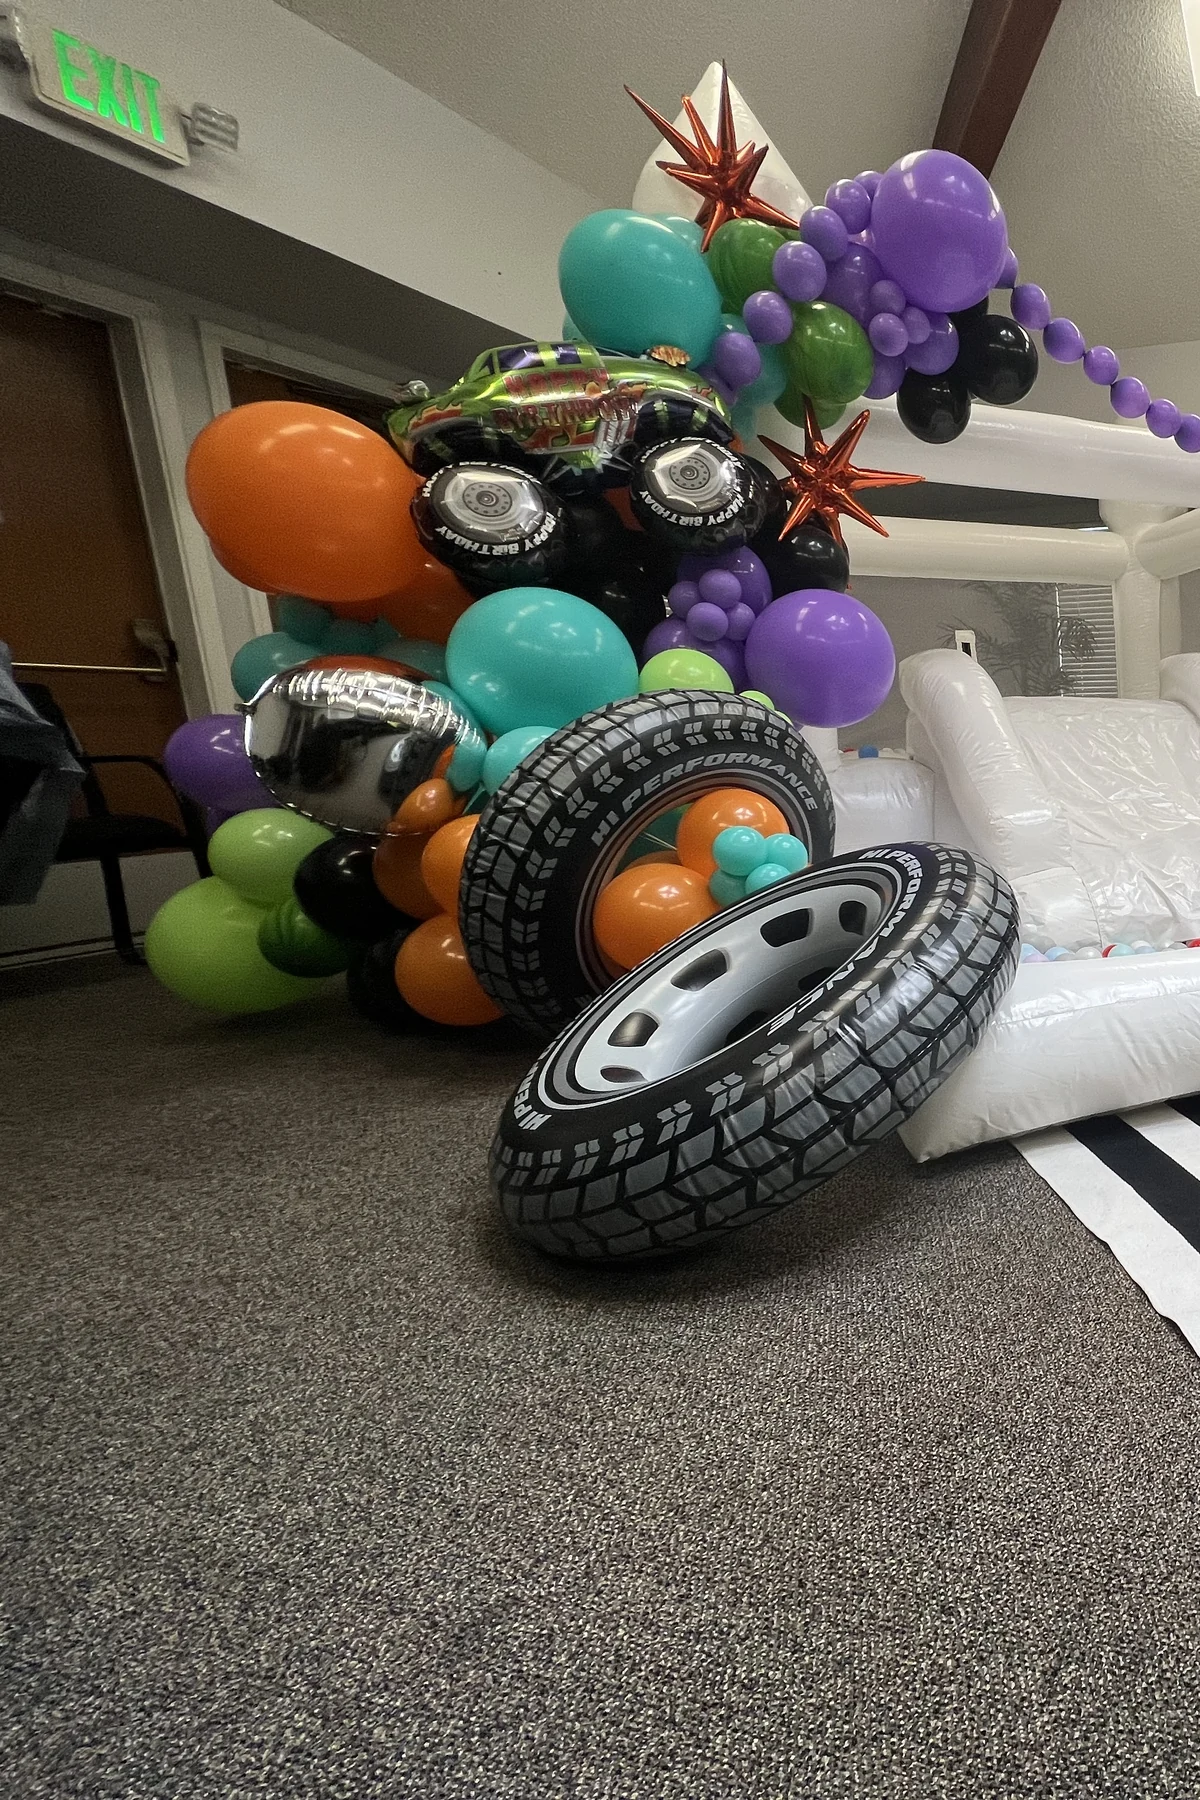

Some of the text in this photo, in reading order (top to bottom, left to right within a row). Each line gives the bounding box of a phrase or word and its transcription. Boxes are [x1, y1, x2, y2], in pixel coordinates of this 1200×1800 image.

[51, 27, 166, 144] EXIT
[502, 367, 610, 398] HAPPY
[591, 752, 819, 847] HI PERFORMANCE
[766, 849, 923, 1037] HI PERFORMANCE
[518, 1110, 553, 1131] HI
